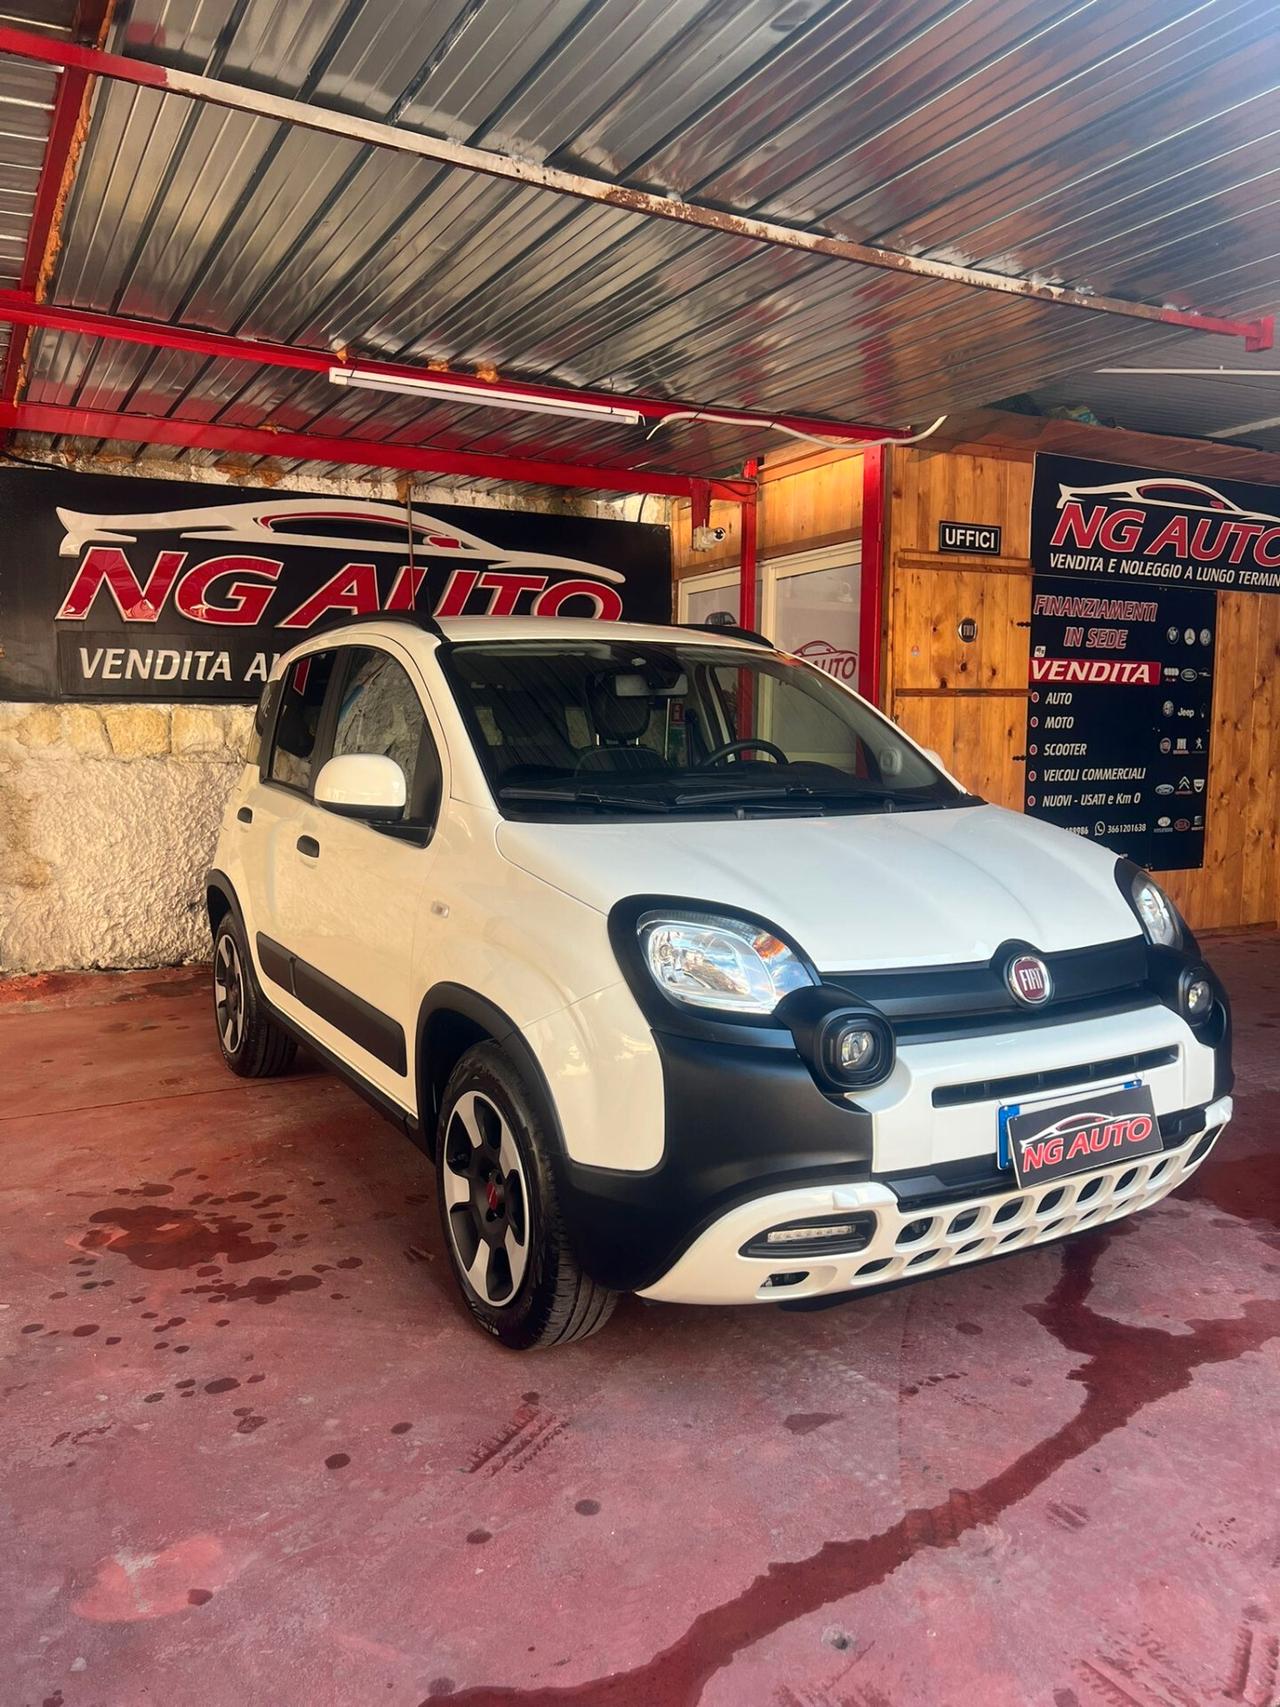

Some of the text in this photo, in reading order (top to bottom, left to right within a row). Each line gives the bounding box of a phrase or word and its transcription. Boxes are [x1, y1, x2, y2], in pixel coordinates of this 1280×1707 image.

[945, 527, 995, 549] UFFICI
[1050, 502, 1147, 552] NG
[1050, 552, 1104, 572] VENDITA
[1108, 557, 1116, 572] E
[1119, 559, 1182, 579] NOLEGGIO
[1184, 565, 1193, 580] A
[1196, 566, 1235, 583] LUNGO
[55, 547, 625, 628] NG AUTO
[1033, 594, 1159, 622] FINANZIAMENTI
[1063, 626, 1128, 649] IN SEDE
[79, 646, 233, 682] VENDITA
[1031, 659, 1151, 684] VENDITA
[1045, 692, 1073, 705] AUTO
[1044, 716, 1074, 729] MOTO
[1177, 707, 1195, 718] Jeep
[1043, 743, 1087, 756] SCOOTER
[1043, 768, 1146, 782] VEICOLI COMMERCIALI
[1042, 794, 1072, 808] NUOVI
[1080, 794, 1106, 806] USATI
[1107, 796, 1114, 805] e
[1116, 794, 1132, 805] Km
[1107, 823, 1147, 834] 3661201638
[1018, 966, 1043, 992] FIAT
[1023, 1115, 1152, 1173] NG AUTO
